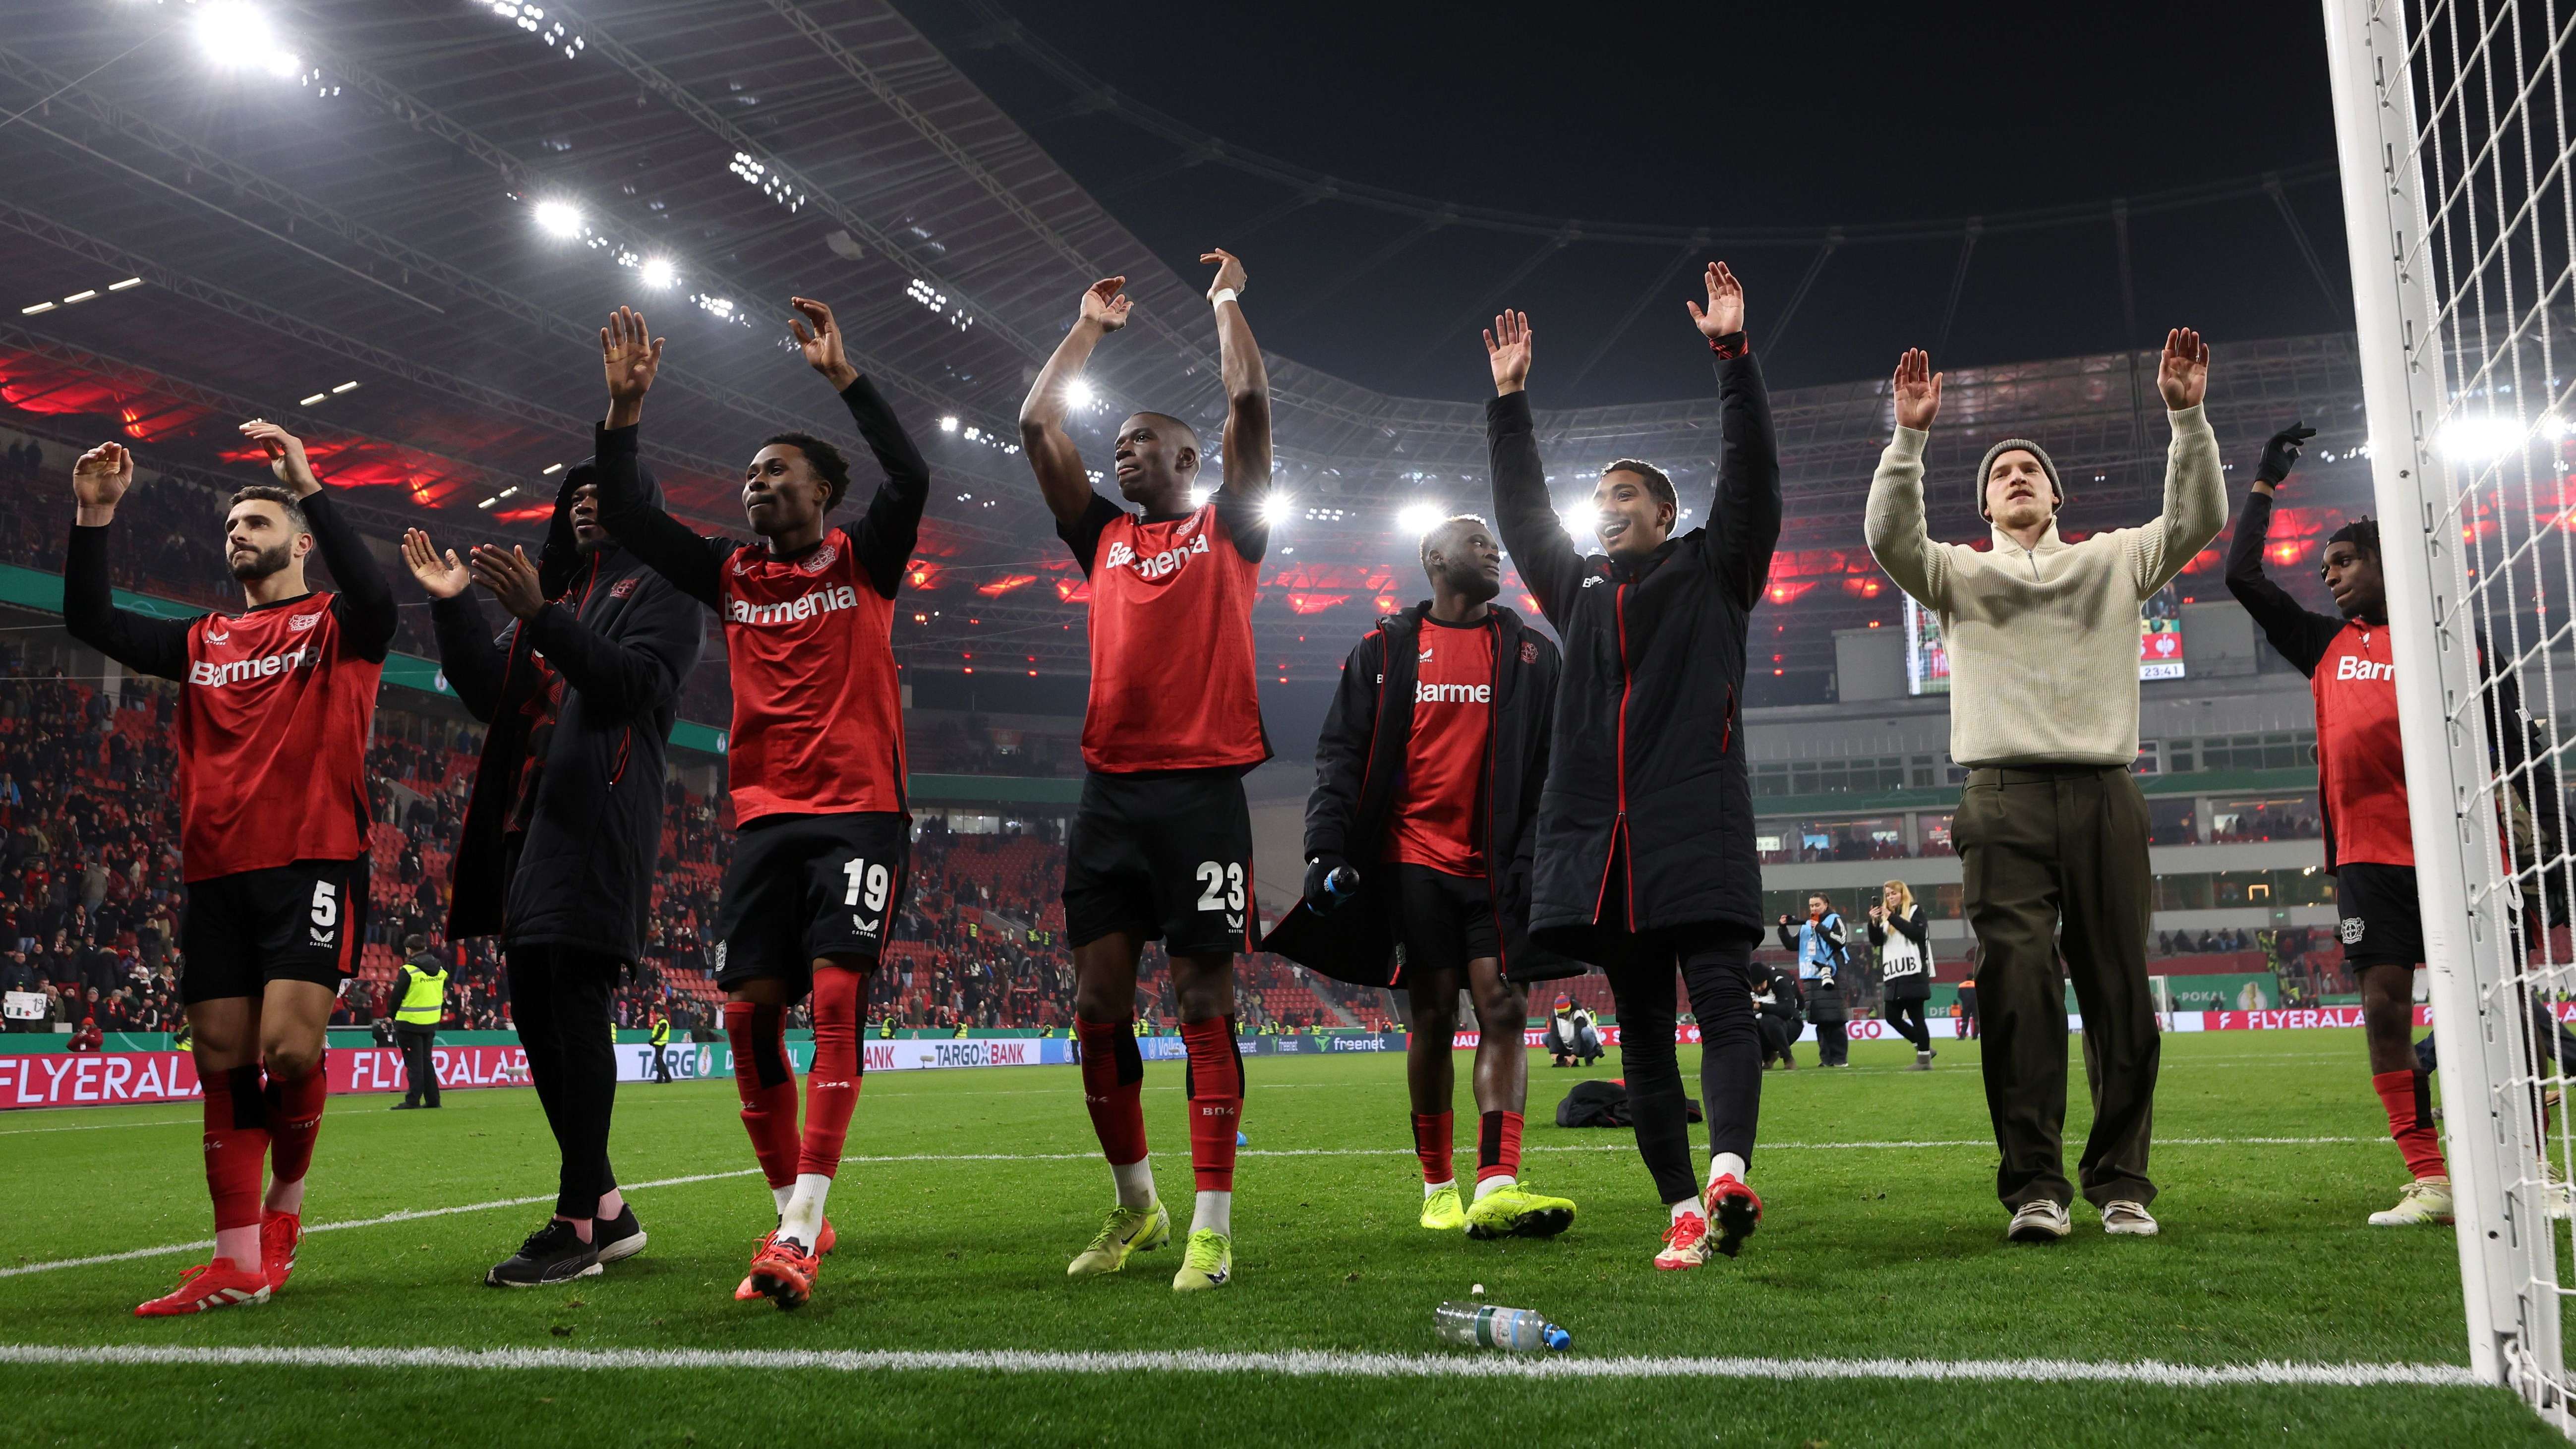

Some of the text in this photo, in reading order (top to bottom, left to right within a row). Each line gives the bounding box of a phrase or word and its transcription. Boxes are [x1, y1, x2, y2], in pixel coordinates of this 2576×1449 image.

[725, 582, 858, 624] Barmenia
[188, 643, 321, 688] Barmenia
[2145, 666, 2178, 677] 23:41
[1415, 680, 1490, 703] Barme
[843, 858, 888, 912] 19
[1196, 861, 1245, 911] 23
[311, 880, 337, 927] 5
[1883, 957, 1916, 977] CLUB
[2248, 1009, 2365, 1030] FLYERALA
[1279, 1040, 1298, 1051] freenet
[1334, 1038, 1386, 1050] freenet
[351, 1049, 529, 1089] FLYRALAR
[864, 1046, 895, 1069] ANK
